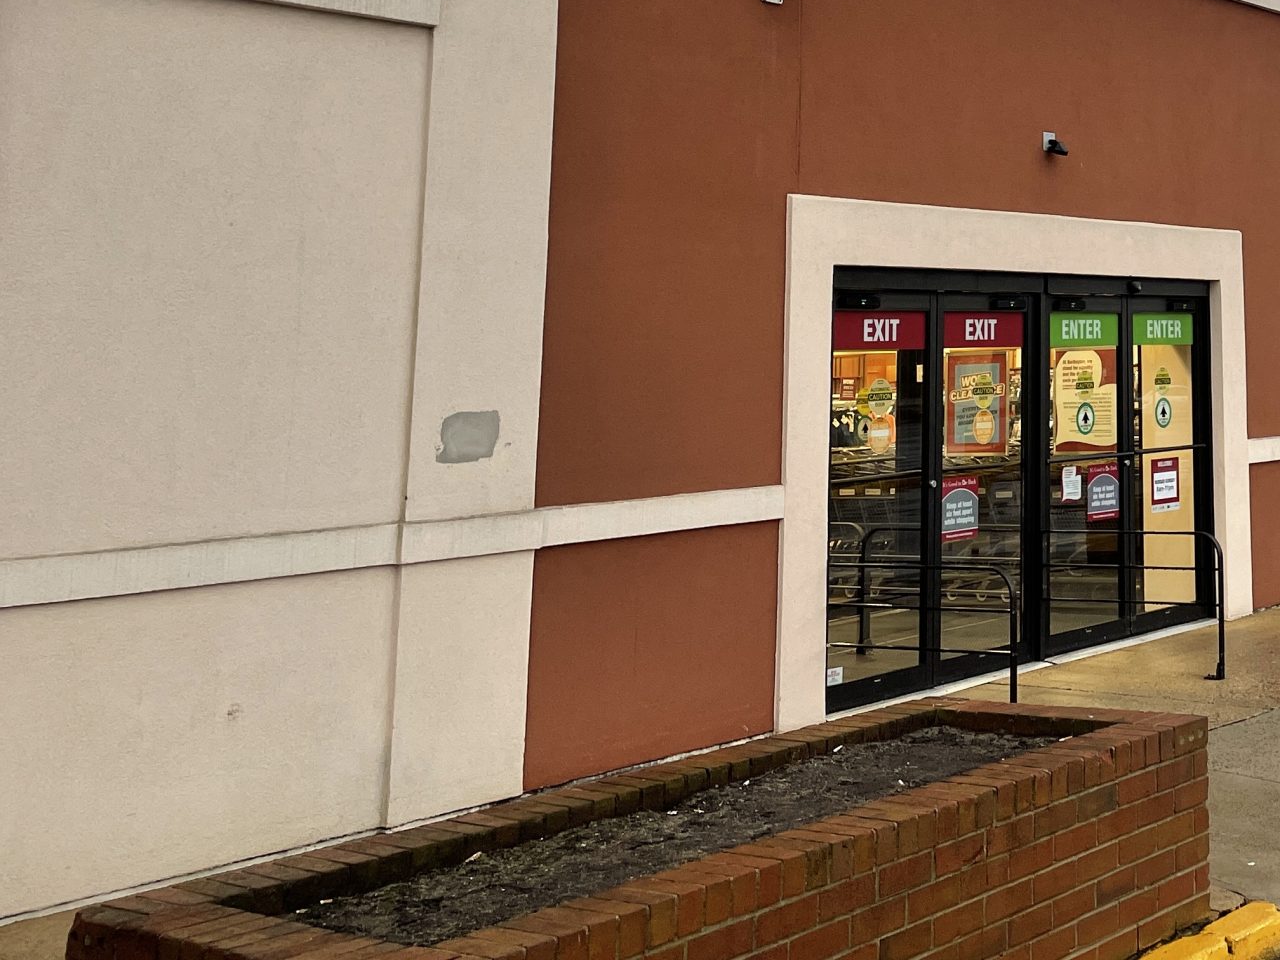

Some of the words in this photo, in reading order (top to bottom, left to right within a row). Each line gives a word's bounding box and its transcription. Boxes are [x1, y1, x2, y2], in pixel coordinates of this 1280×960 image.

[863, 318, 900, 342] EXIT
[965, 318, 997, 341] EXIT
[1061, 319, 1101, 340] ENTER
[1146, 319, 1181, 339] ENTER
[956, 516, 975, 524] shopping
